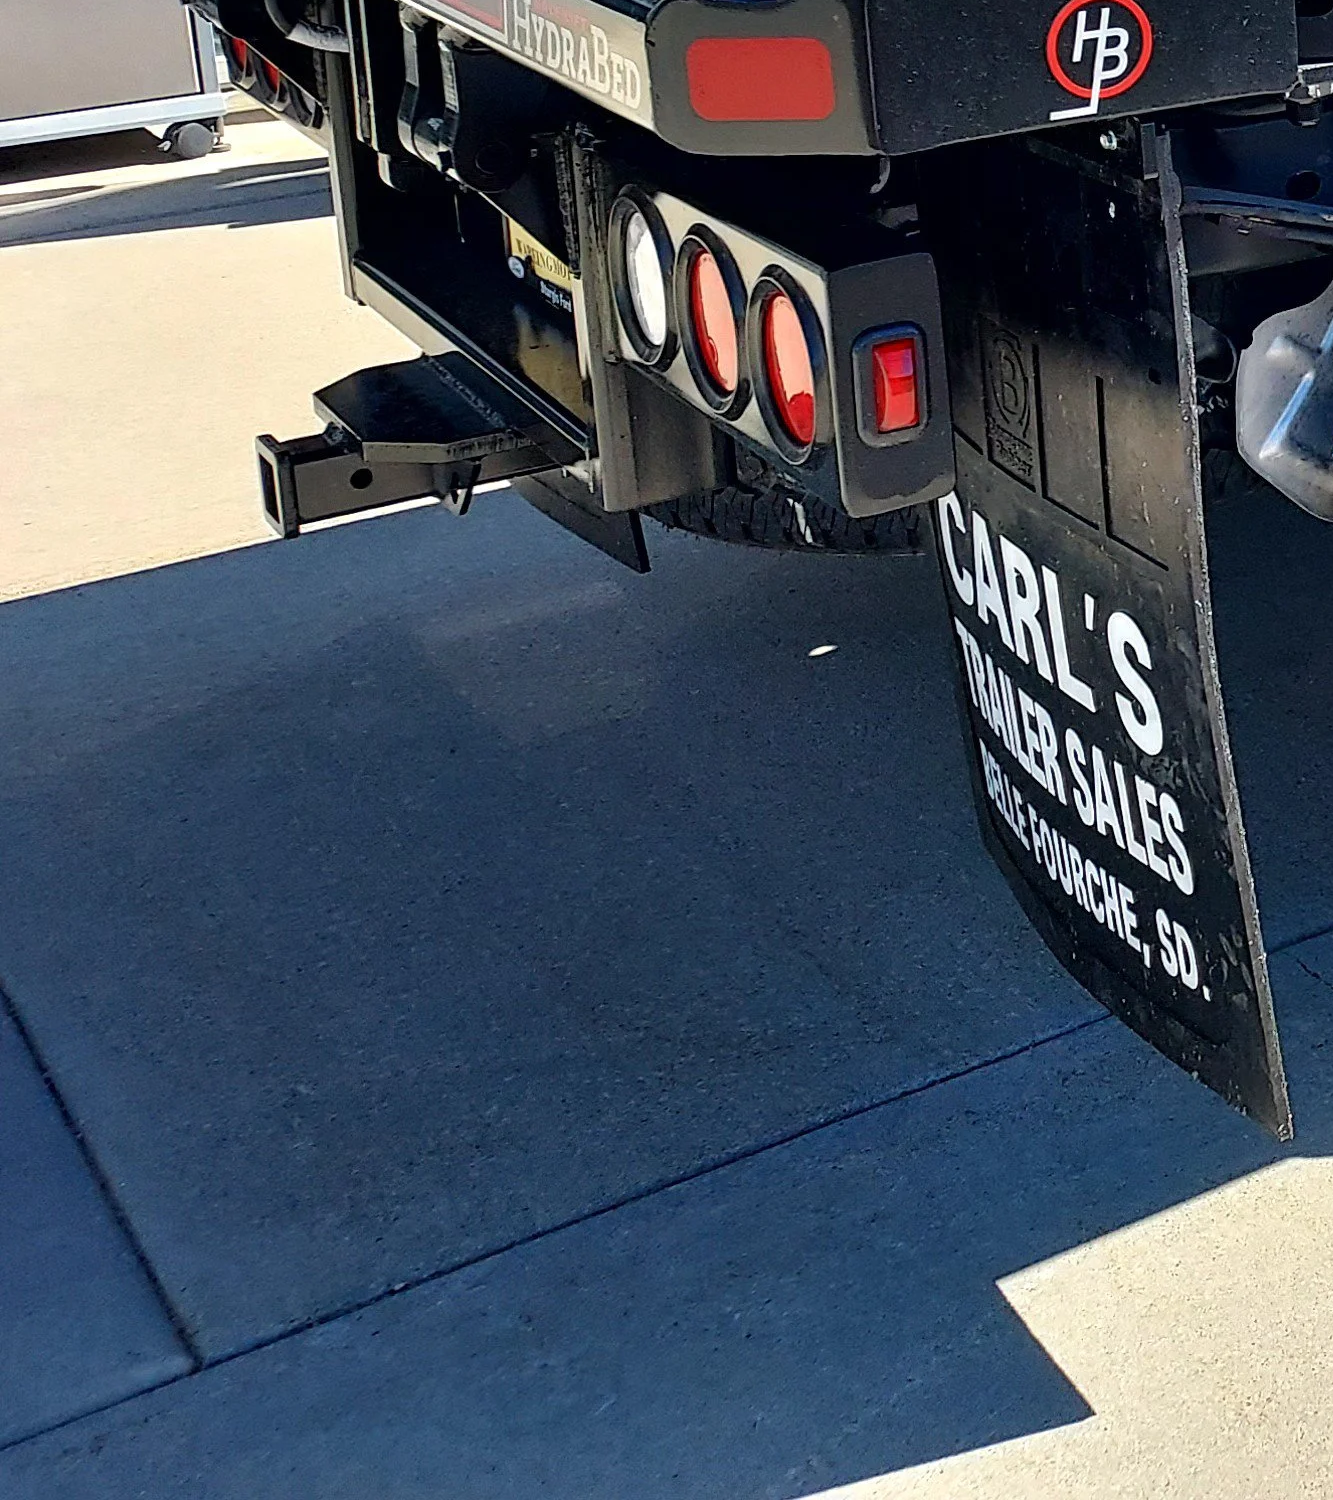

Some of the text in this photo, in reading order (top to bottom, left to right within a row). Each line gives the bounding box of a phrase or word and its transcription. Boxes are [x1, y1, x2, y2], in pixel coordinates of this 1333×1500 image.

[937, 489, 1164, 757] CARL'S
[953, 615, 1195, 896] TRAILER SALES
[978, 736, 1212, 1002] BELLE FOURCHE, SD.
